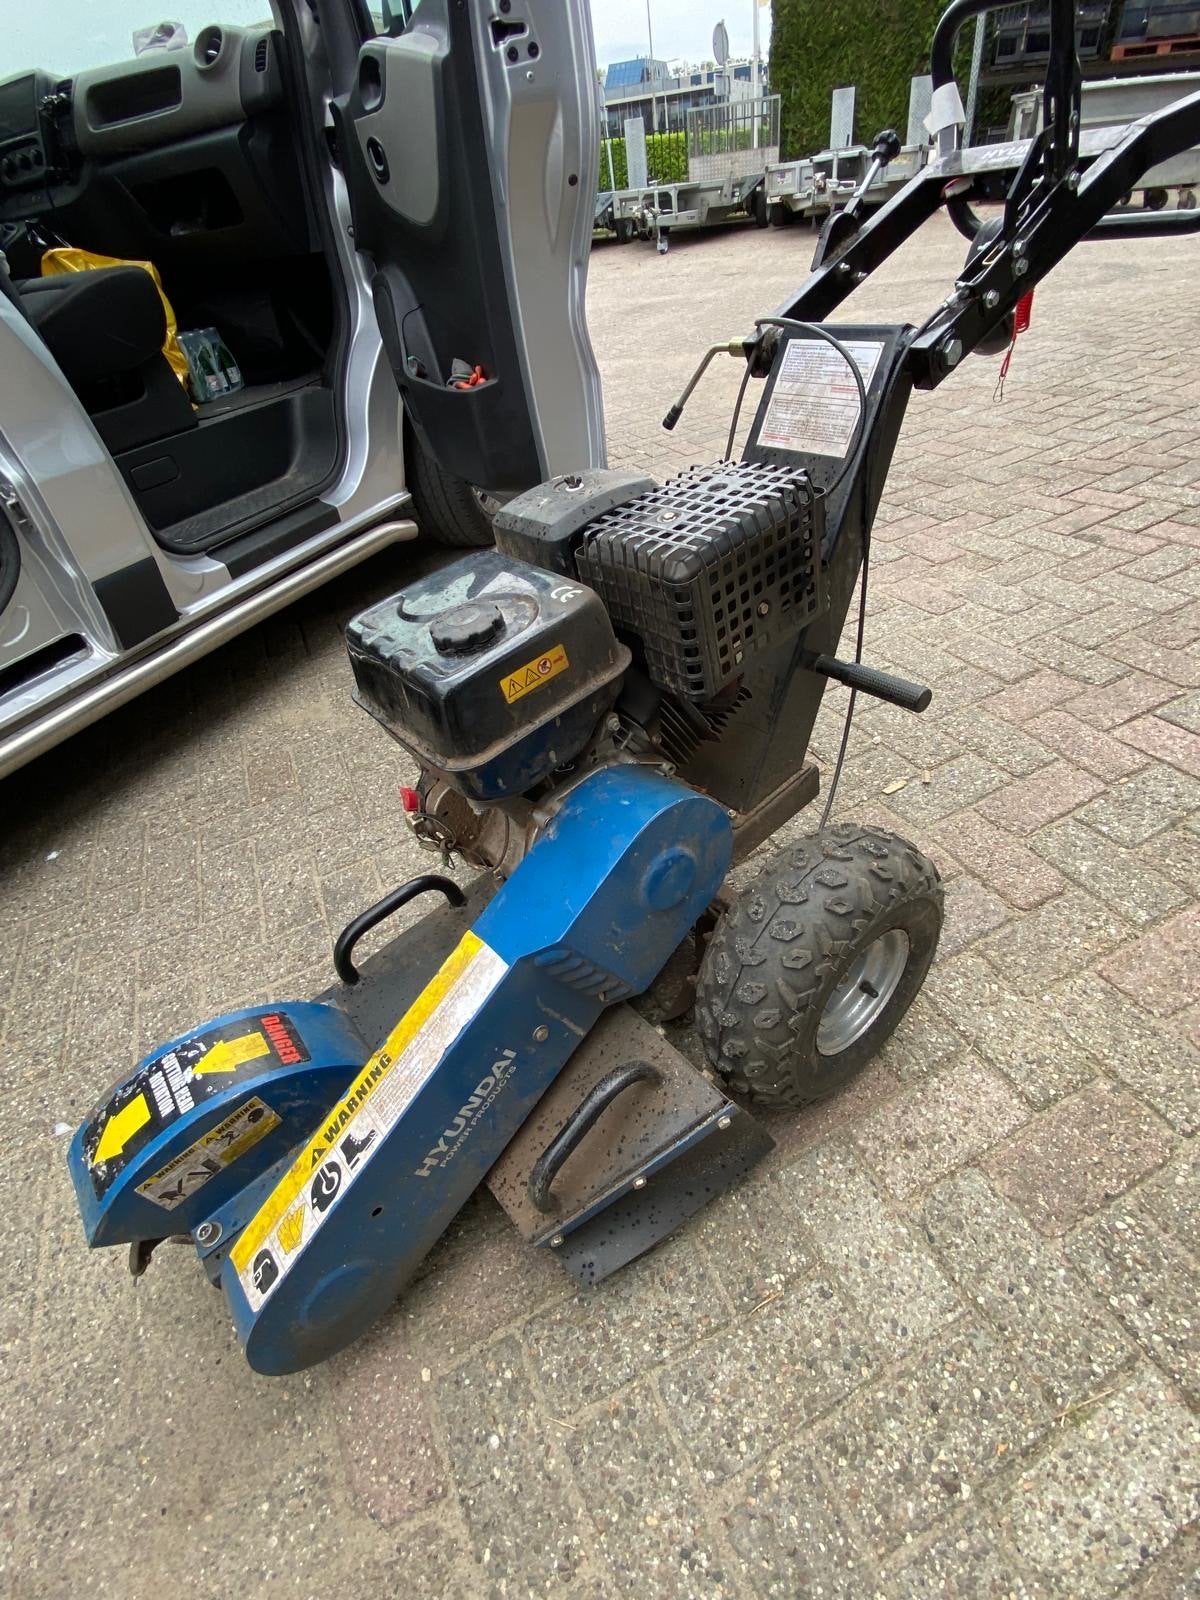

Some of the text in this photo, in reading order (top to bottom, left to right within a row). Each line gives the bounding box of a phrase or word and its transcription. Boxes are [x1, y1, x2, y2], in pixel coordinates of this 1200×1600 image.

[260, 1013, 303, 1065] DANGER
[148, 1070, 176, 1118] ROTATION
[161, 1052, 195, 1115] CUTTING HEAD
[324, 1053, 393, 1144] WARNING
[215, 1102, 256, 1134] WARNING
[414, 1048, 517, 1177] HYUNDAI
[440, 1065, 517, 1168] POWER PRODUCTS
[156, 1147, 196, 1178] WARNING
